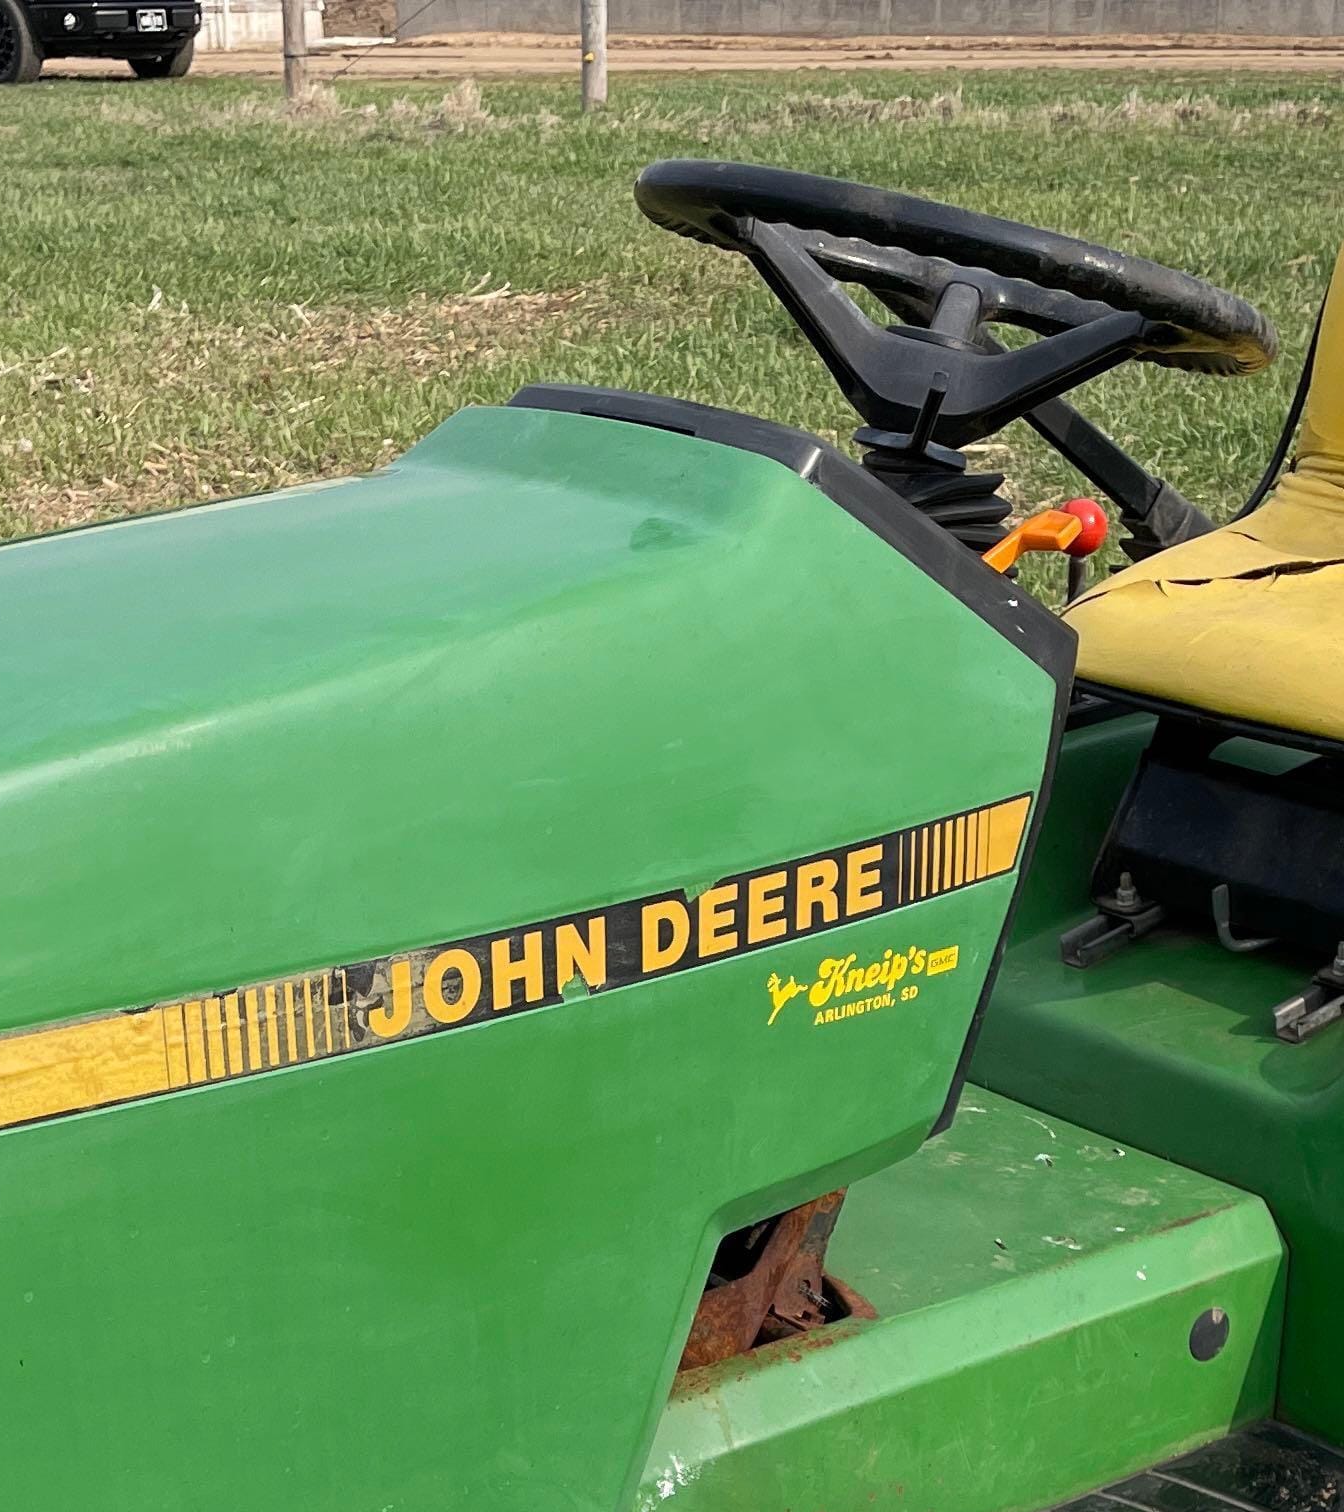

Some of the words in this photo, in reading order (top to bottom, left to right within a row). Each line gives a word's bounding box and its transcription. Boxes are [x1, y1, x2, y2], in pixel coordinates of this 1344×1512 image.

[368, 915, 607, 1039] JOHN
[640, 843, 884, 974] DEERE
[809, 945, 927, 1007] Kneip's
[814, 992, 896, 1026] ARLINGTON,
[900, 985, 919, 1001] SD
